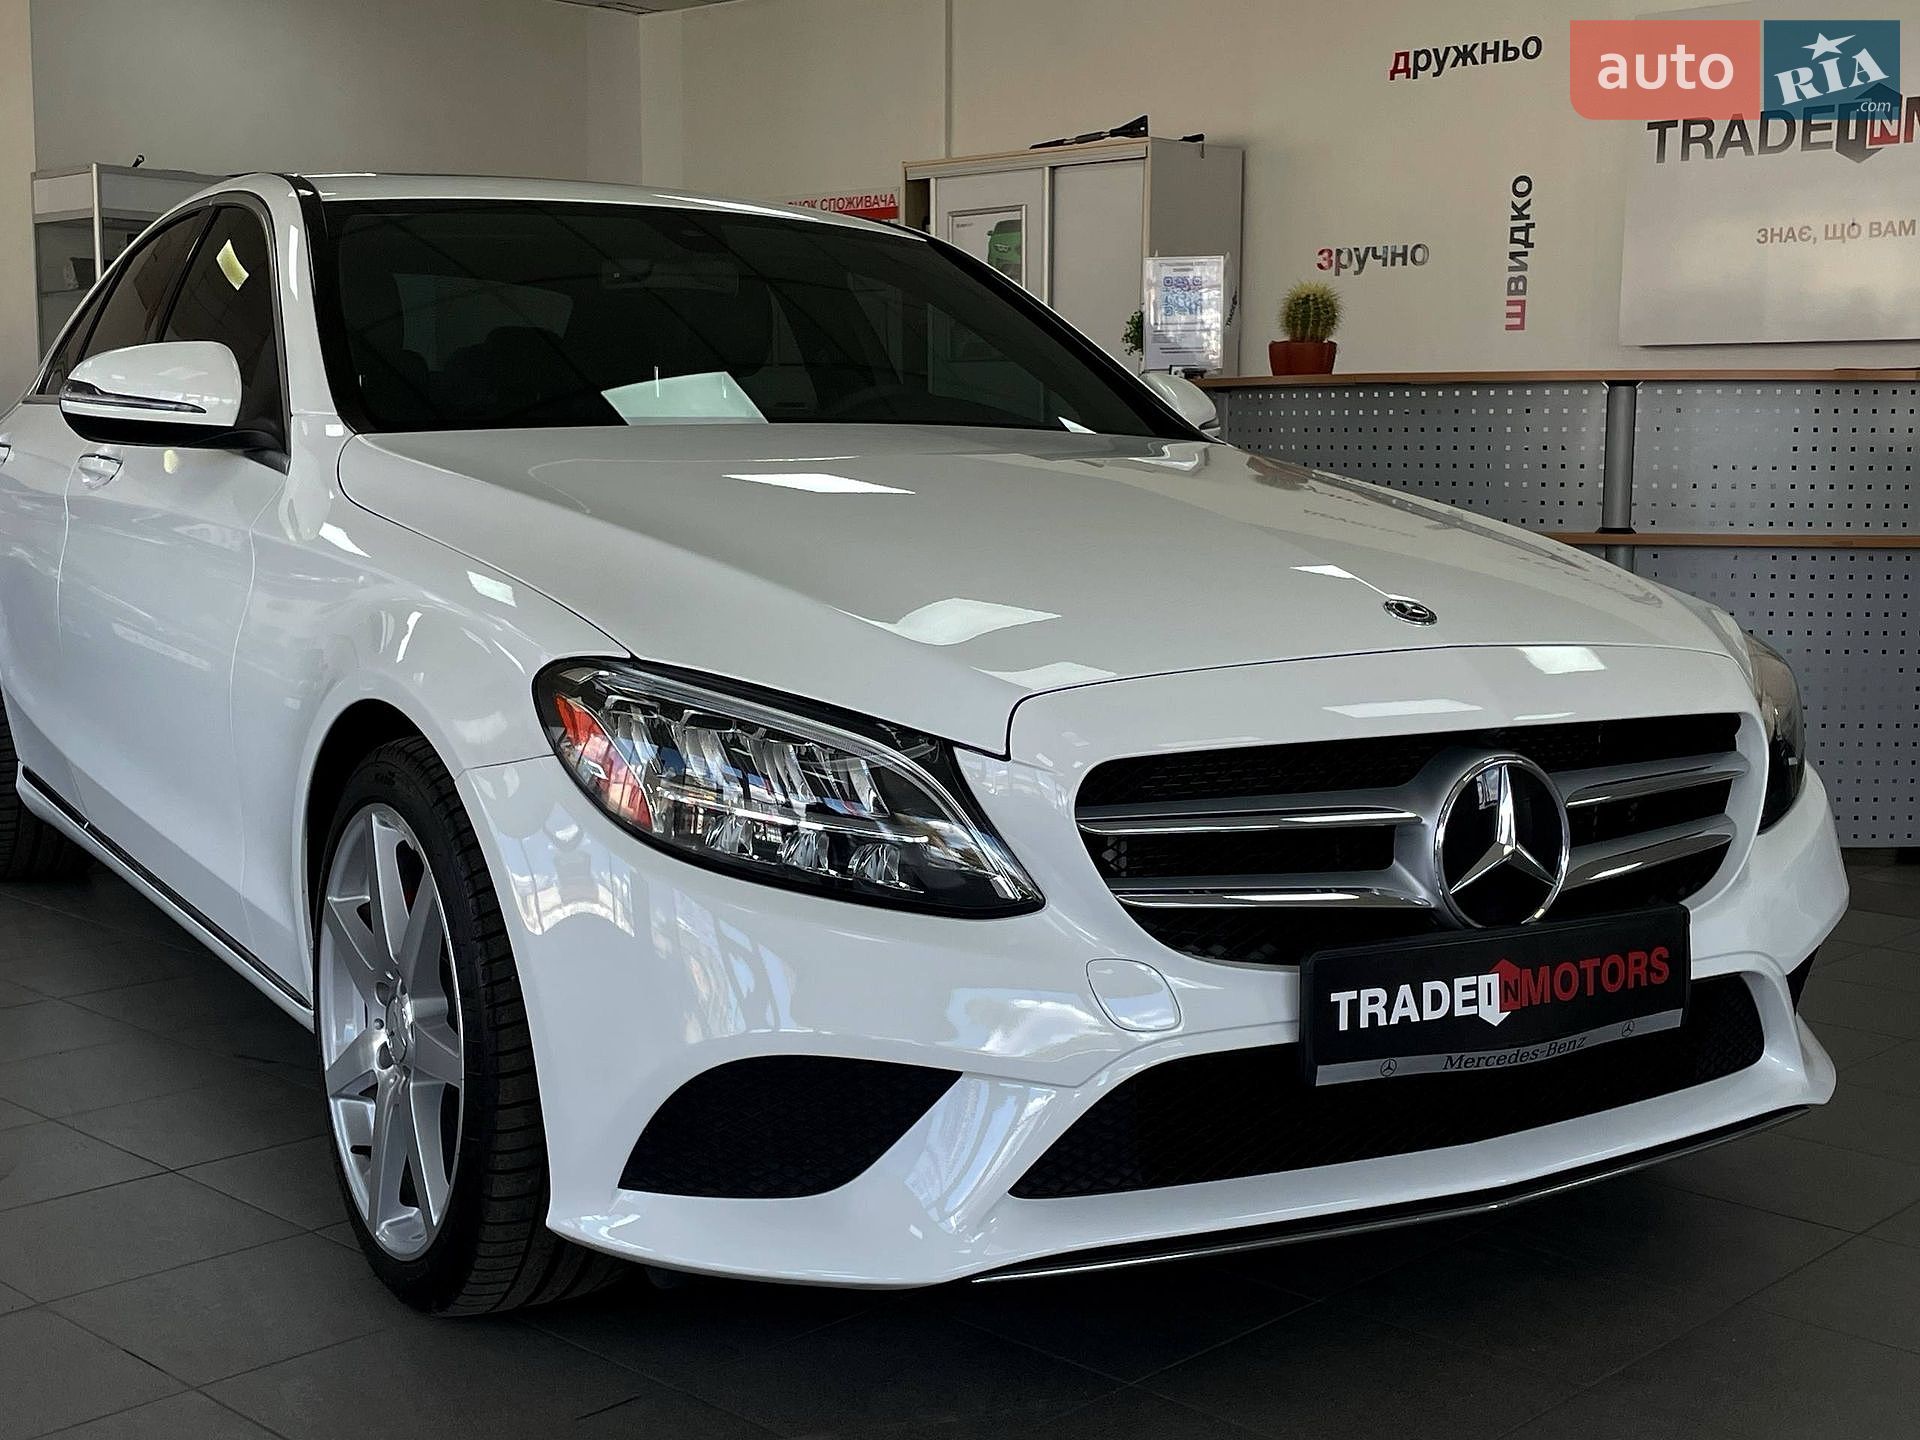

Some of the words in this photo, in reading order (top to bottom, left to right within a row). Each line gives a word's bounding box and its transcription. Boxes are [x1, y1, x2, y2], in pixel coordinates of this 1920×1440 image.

[1389, 35, 1542, 80] дружньо
[820, 194, 896, 212] СПОЖИВАЧА
[1756, 225, 1817, 244] ЗНАЄ,
[1825, 223, 1862, 243] ЩО
[1869, 219, 1916, 238] ВАМ
[1316, 243, 1430, 276] зручно
[1505, 175, 1535, 330] швидко
[1442, 1036, 1587, 1070] Mercedes-Benz
